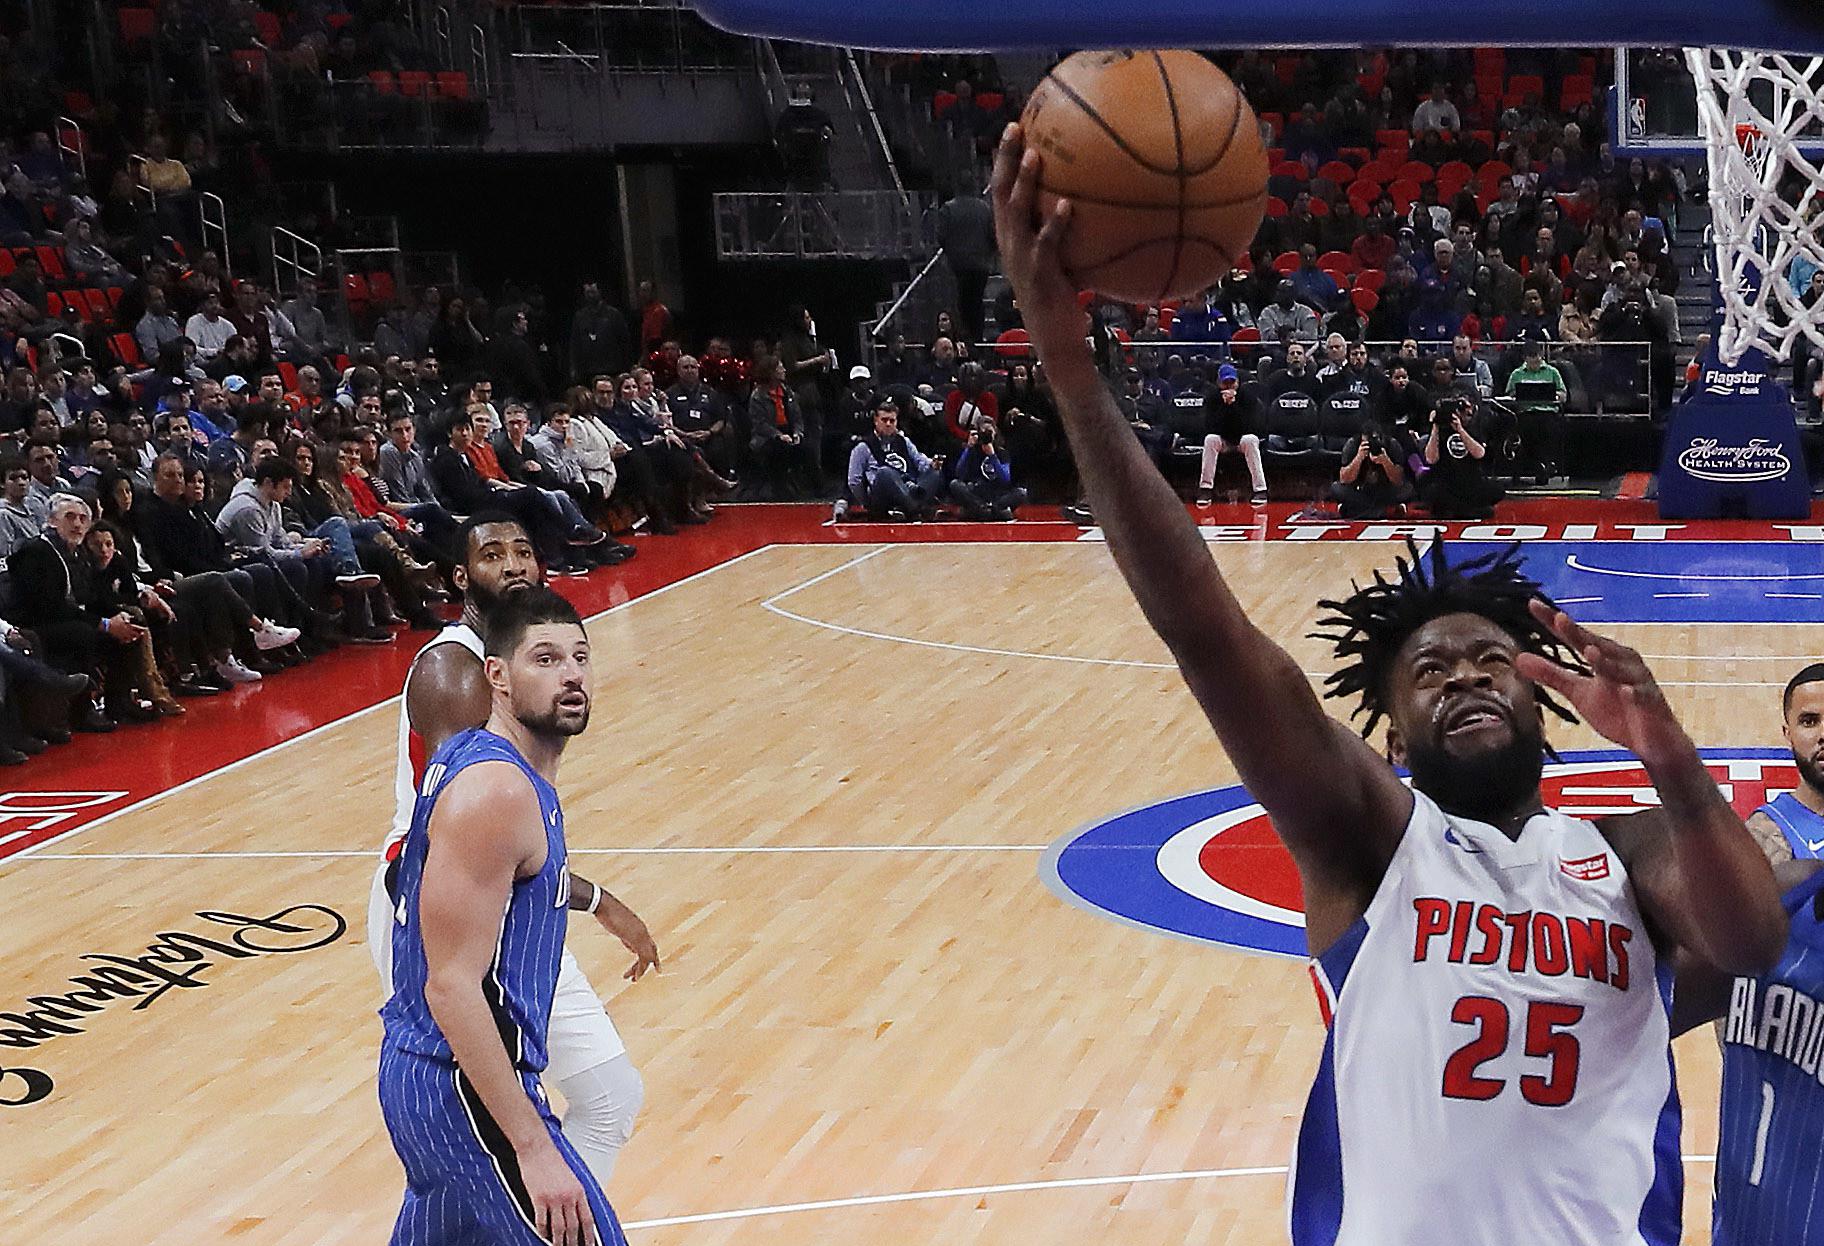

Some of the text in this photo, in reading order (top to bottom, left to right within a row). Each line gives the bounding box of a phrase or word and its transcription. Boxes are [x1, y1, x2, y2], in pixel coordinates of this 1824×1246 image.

[1705, 371, 1761, 386] Flagstar
[1739, 386, 1759, 395] Bank
[1690, 438, 1782, 462] Henry Ford
[1685, 459, 1786, 469] HEALTH SYSTEM
[1413, 898, 1632, 992] PISTONS
[1442, 996, 1585, 1107] 25
[1749, 1080, 1776, 1186] 1
